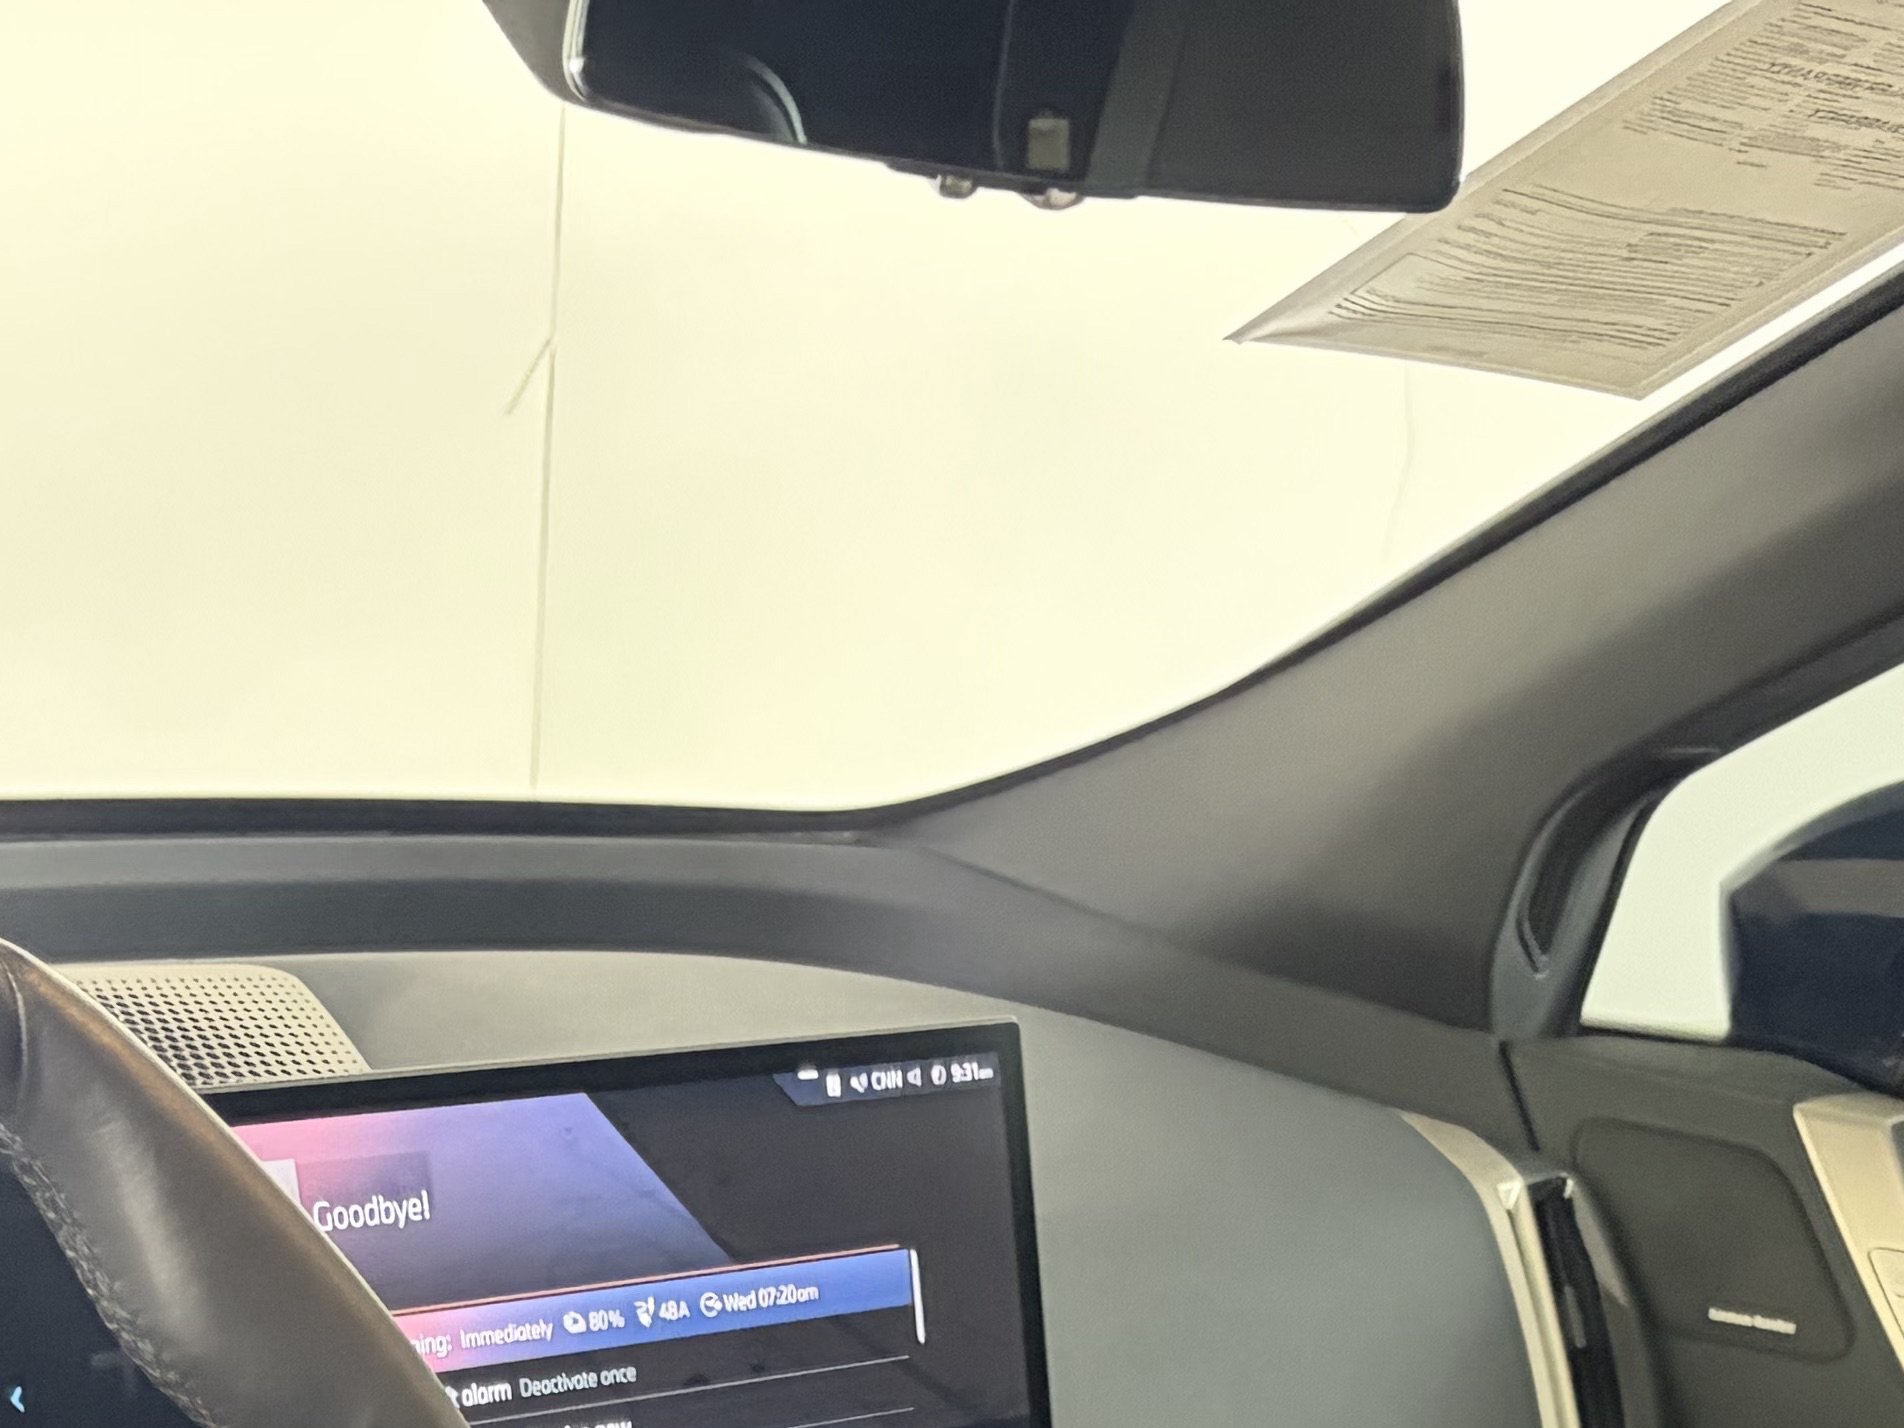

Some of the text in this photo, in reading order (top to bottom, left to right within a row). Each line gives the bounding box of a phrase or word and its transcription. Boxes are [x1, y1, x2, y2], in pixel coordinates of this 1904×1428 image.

[313, 1189, 431, 1232] Goodbye!
[460, 1319, 554, 1350] Immediately
[588, 1310, 625, 1332] 80%
[658, 1300, 691, 1321] 48A
[723, 1290, 757, 1312] Wed
[461, 1382, 513, 1407] alarm
[519, 1372, 598, 1398] Deactivate
[600, 1366, 637, 1386] once
